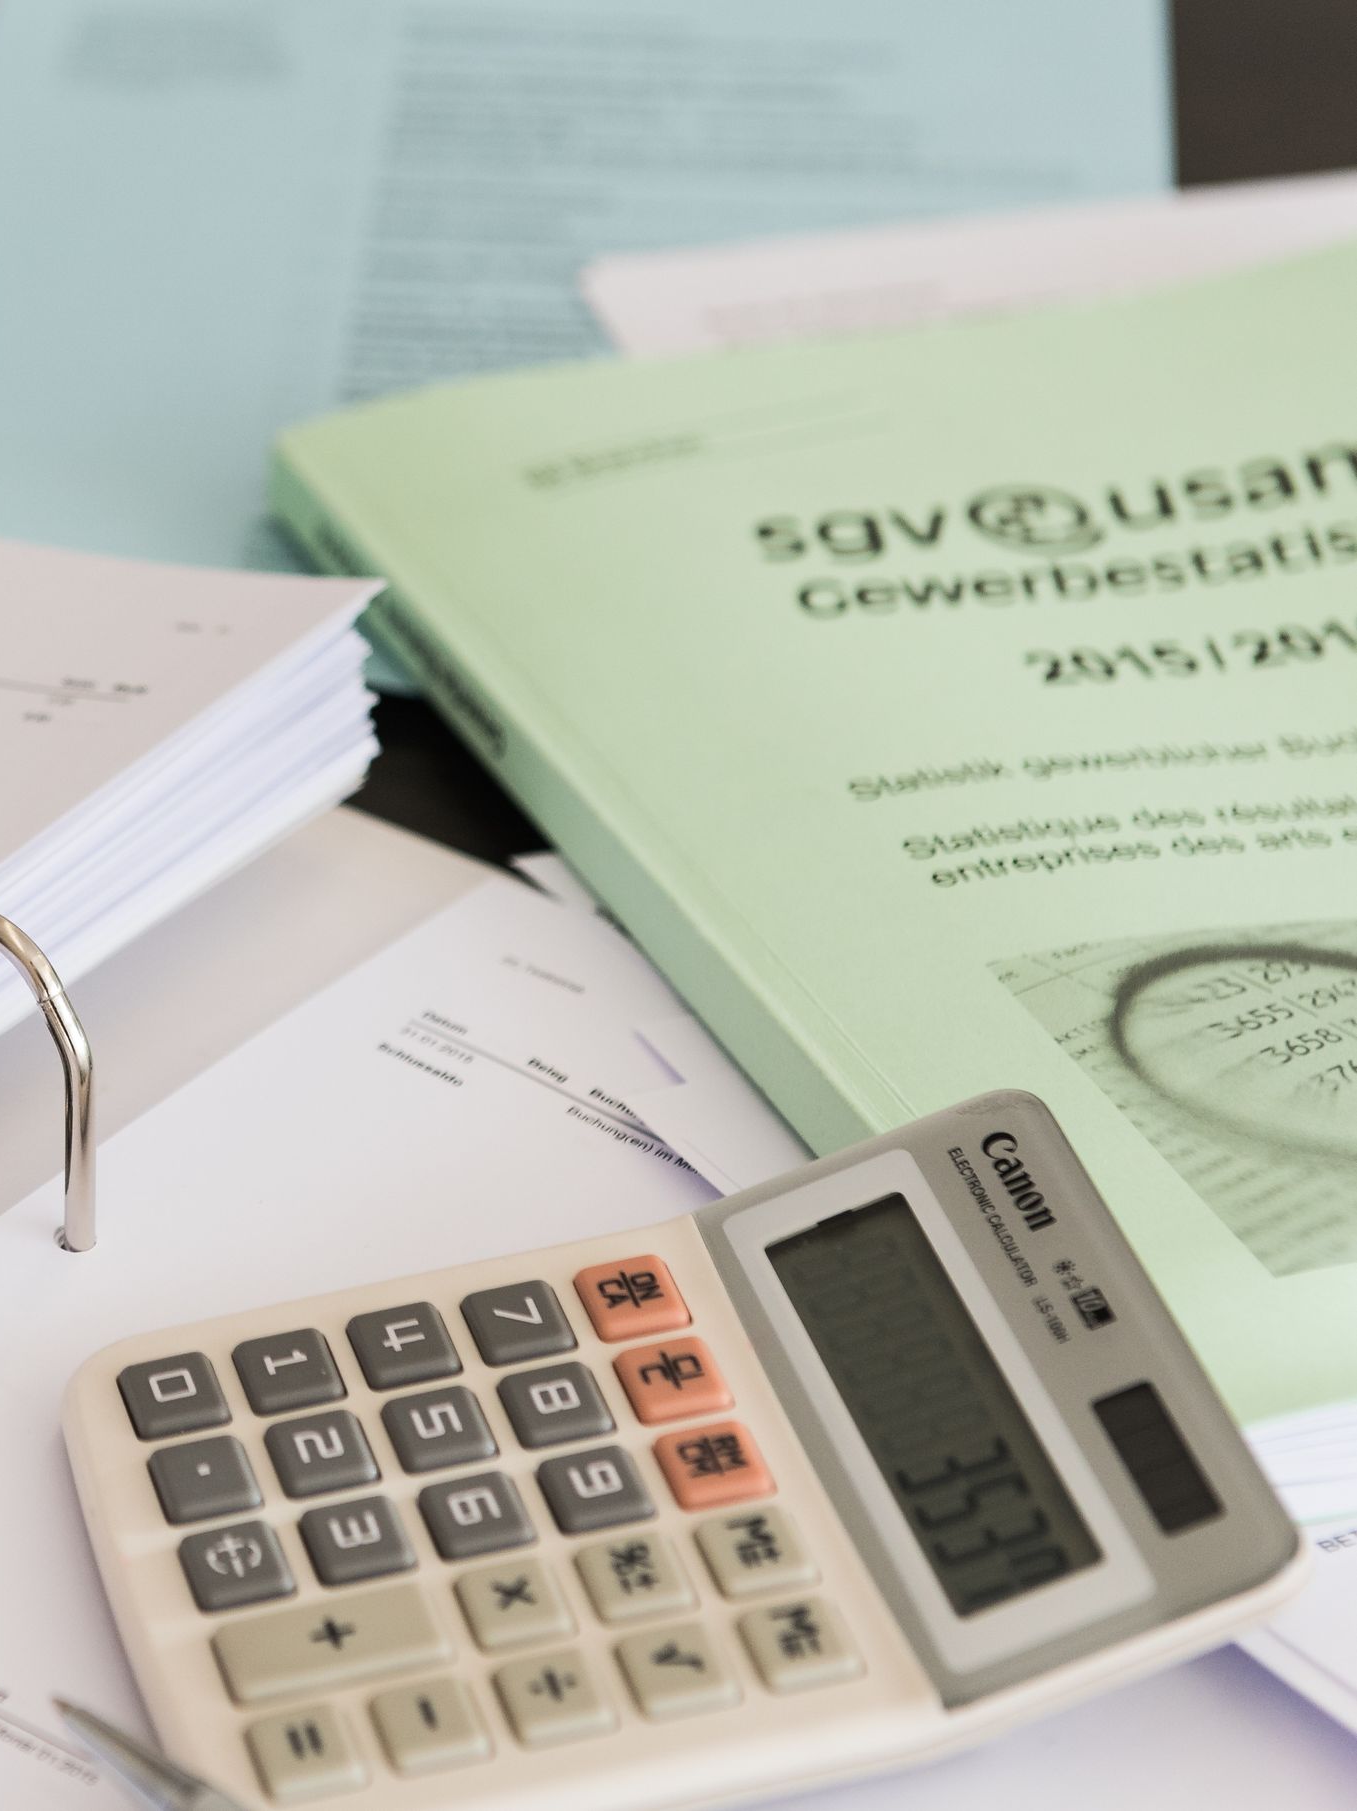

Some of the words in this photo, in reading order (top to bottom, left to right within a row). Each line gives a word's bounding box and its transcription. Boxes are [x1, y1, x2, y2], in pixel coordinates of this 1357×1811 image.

[755, 506, 944, 564] sgv
[847, 758, 1013, 803] Statistik
[902, 812, 1121, 862] Statistique
[1131, 806, 1206, 831] des
[931, 839, 1161, 888] entreprises
[1170, 832, 1246, 858] des
[1256, 827, 1332, 854] arts
[1259, 1028, 1343, 1065] 3658
[981, 1131, 1057, 1232] Canon
[947, 1145, 996, 1215] ELECTRONIC
[986, 1213, 1038, 1288] CALCULATOR
[597, 1278, 630, 1309] CA
[634, 1270, 665, 1301] ON
[493, 1296, 544, 1325] 7
[382, 1317, 426, 1353] 4
[263, 1348, 309, 1377] 1
[147, 1366, 198, 1404] 0
[529, 1378, 583, 1416] 8
[408, 1401, 464, 1440] 5
[291, 1424, 345, 1464] 2
[567, 1460, 626, 1500] 9
[446, 1486, 503, 1528] 6
[328, 1509, 383, 1550] 3
